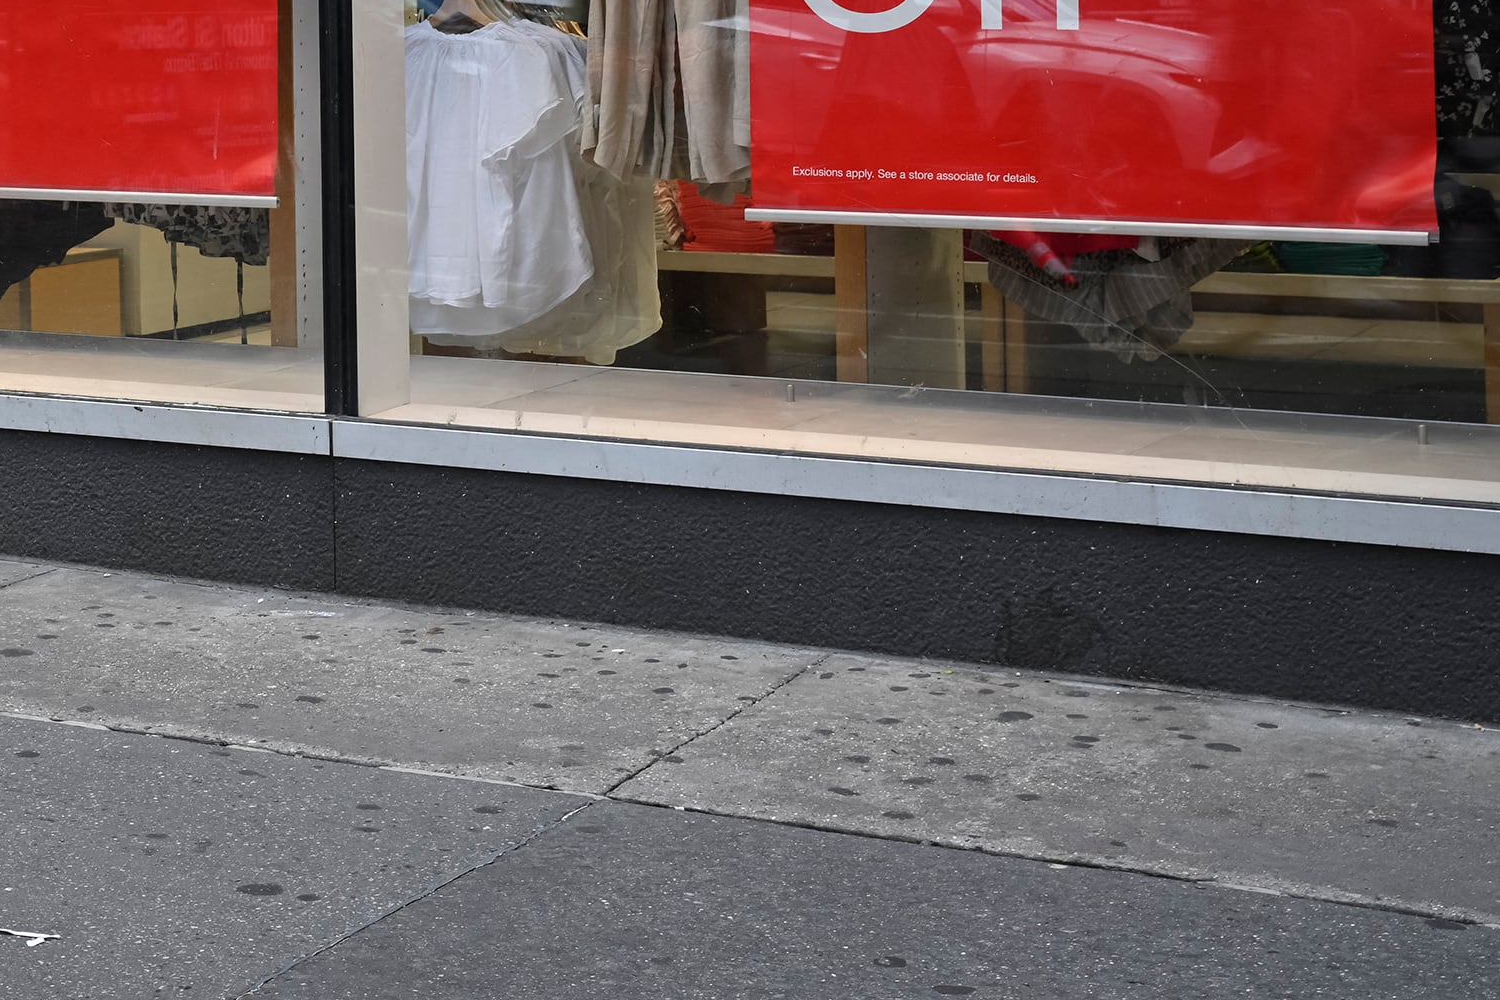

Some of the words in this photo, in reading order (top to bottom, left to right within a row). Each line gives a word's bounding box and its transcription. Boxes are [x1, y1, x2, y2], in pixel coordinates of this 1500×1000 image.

[792, 166, 844, 178] Exclusions
[845, 168, 875, 180] apply.
[877, 169, 897, 179] See
[899, 171, 906, 179] a
[908, 170, 934, 181] store
[936, 171, 984, 182] associate
[986, 172, 1001, 182] for
[1002, 172, 1039, 184] details.
